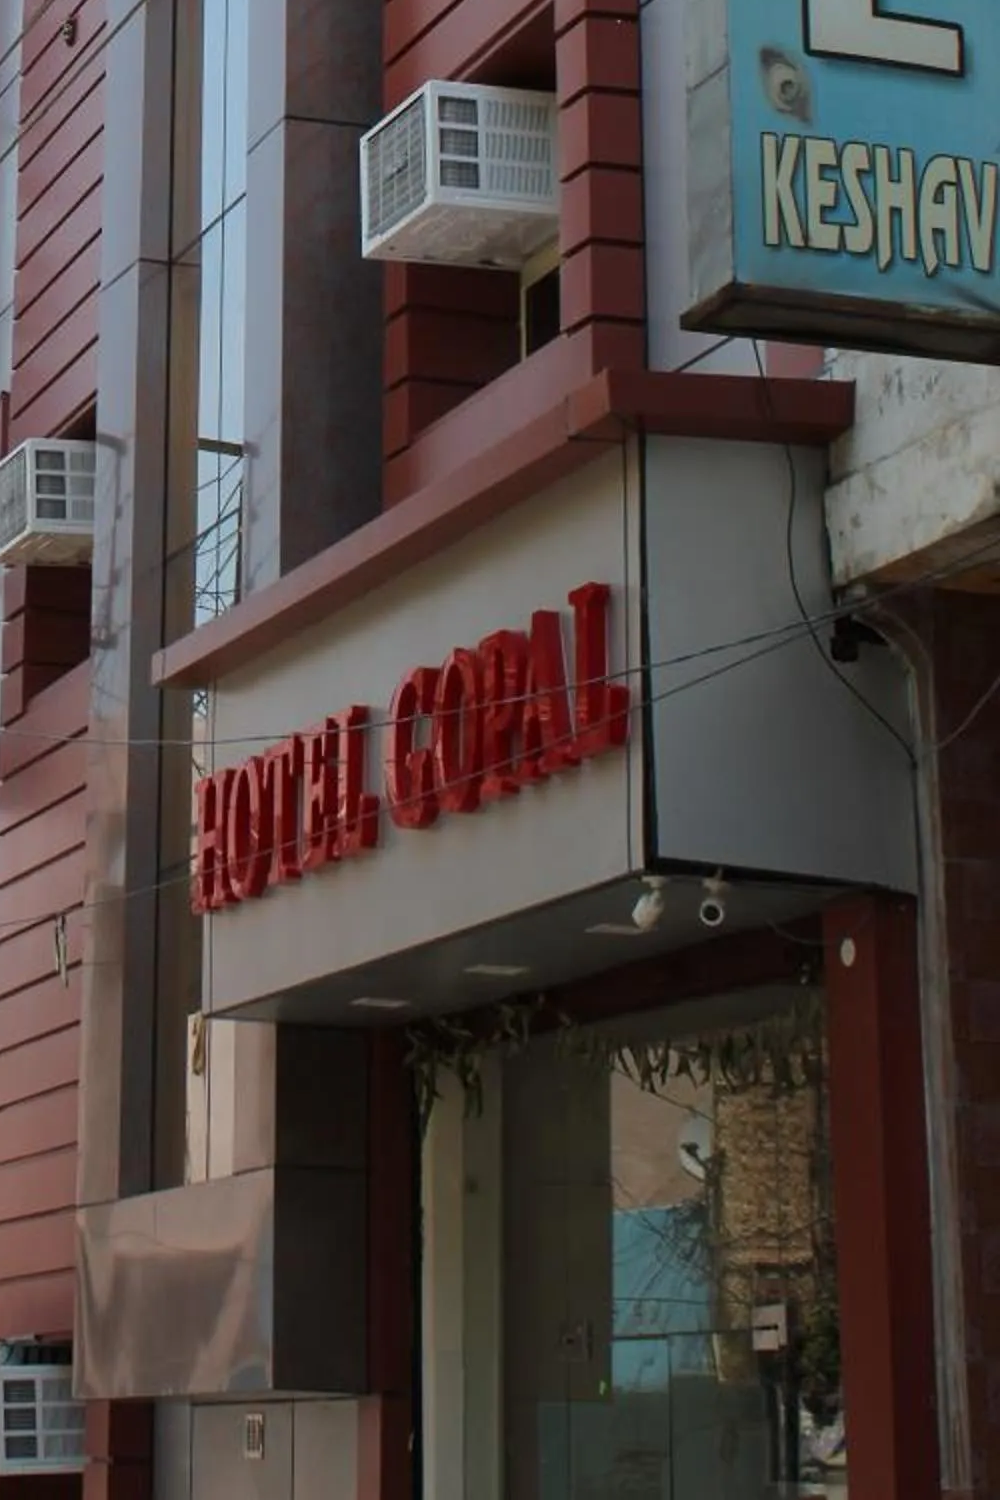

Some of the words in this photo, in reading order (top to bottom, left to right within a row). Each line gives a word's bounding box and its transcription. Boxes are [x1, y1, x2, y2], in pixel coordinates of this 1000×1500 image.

[759, 131, 998, 278] KESHAV
[191, 705, 380, 914] HOTEL
[383, 580, 630, 830] GOPAL
